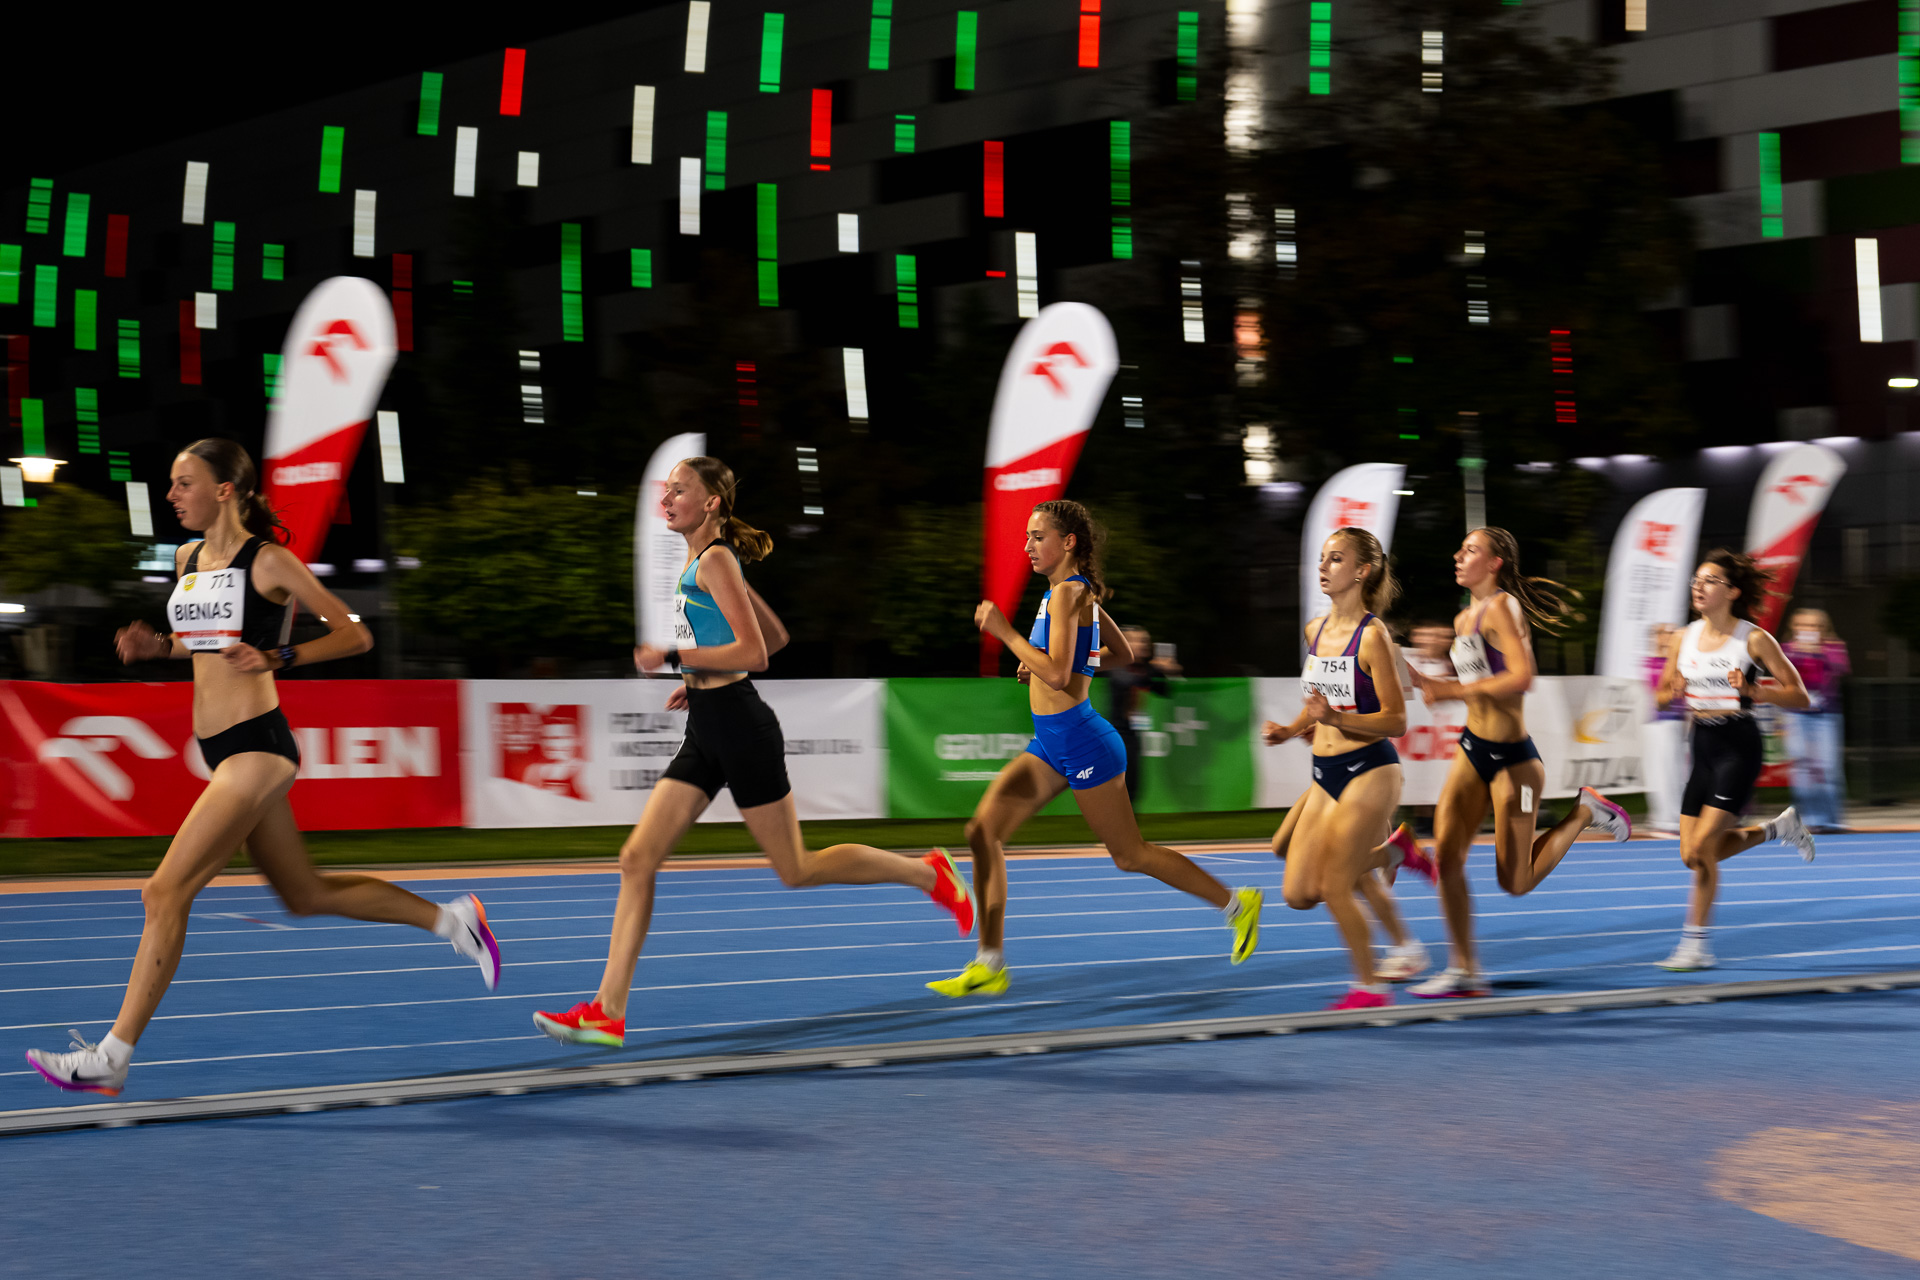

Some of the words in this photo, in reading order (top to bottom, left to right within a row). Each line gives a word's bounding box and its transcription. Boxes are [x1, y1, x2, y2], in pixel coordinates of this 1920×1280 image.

[211, 573, 235, 590] 771
[175, 602, 233, 621] BIENIAS
[1321, 660, 1347, 673] 754
[183, 726, 442, 781] LEN
[1076, 766, 1094, 779] 4F
